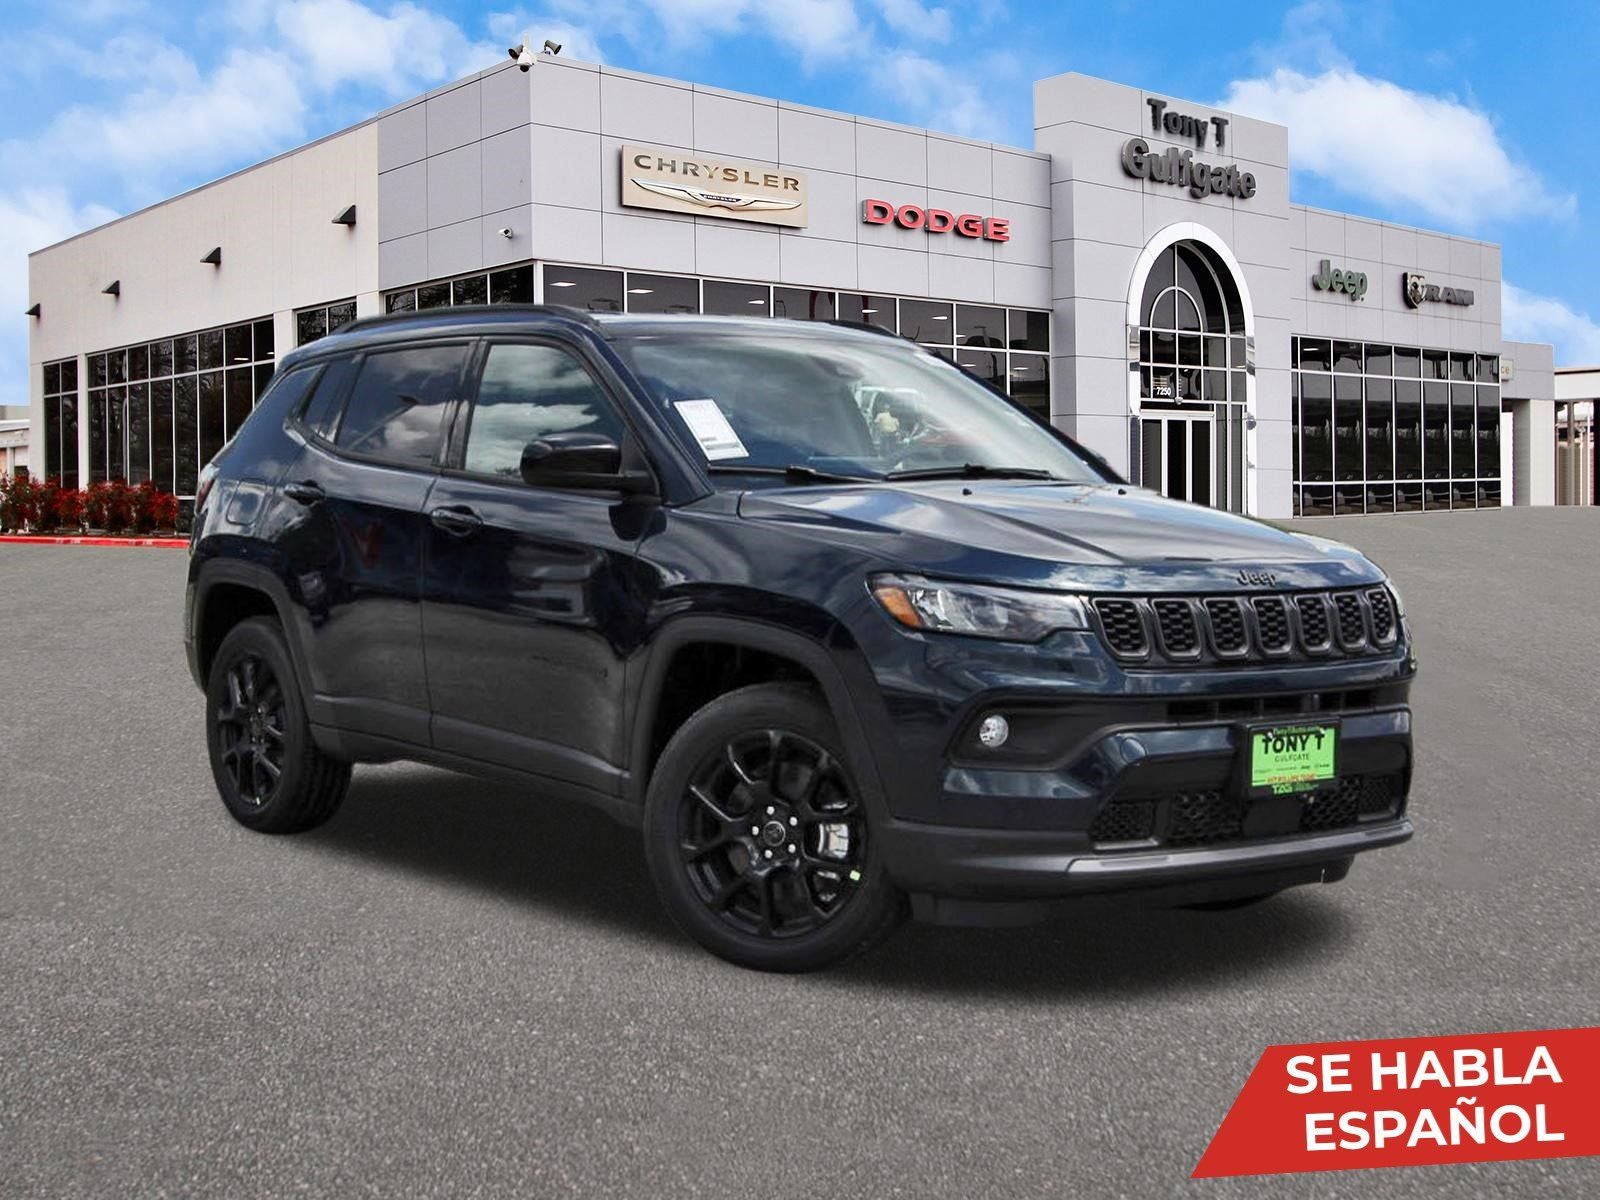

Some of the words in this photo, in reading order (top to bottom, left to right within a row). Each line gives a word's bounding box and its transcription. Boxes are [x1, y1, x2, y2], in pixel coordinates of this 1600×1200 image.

[1146, 97, 1208, 148] Tony
[1210, 116, 1229, 147] T
[633, 153, 800, 192] CHRYSLER
[1121, 137, 1256, 199] Gulfgate
[862, 198, 1011, 242] DODGE
[1313, 259, 1368, 301] Jeep
[1425, 284, 1475, 306] RAM
[1156, 387, 1172, 396] 7250
[1237, 568, 1276, 587] Jeep
[1262, 733, 1310, 754] TONY
[1315, 731, 1326, 750] T
